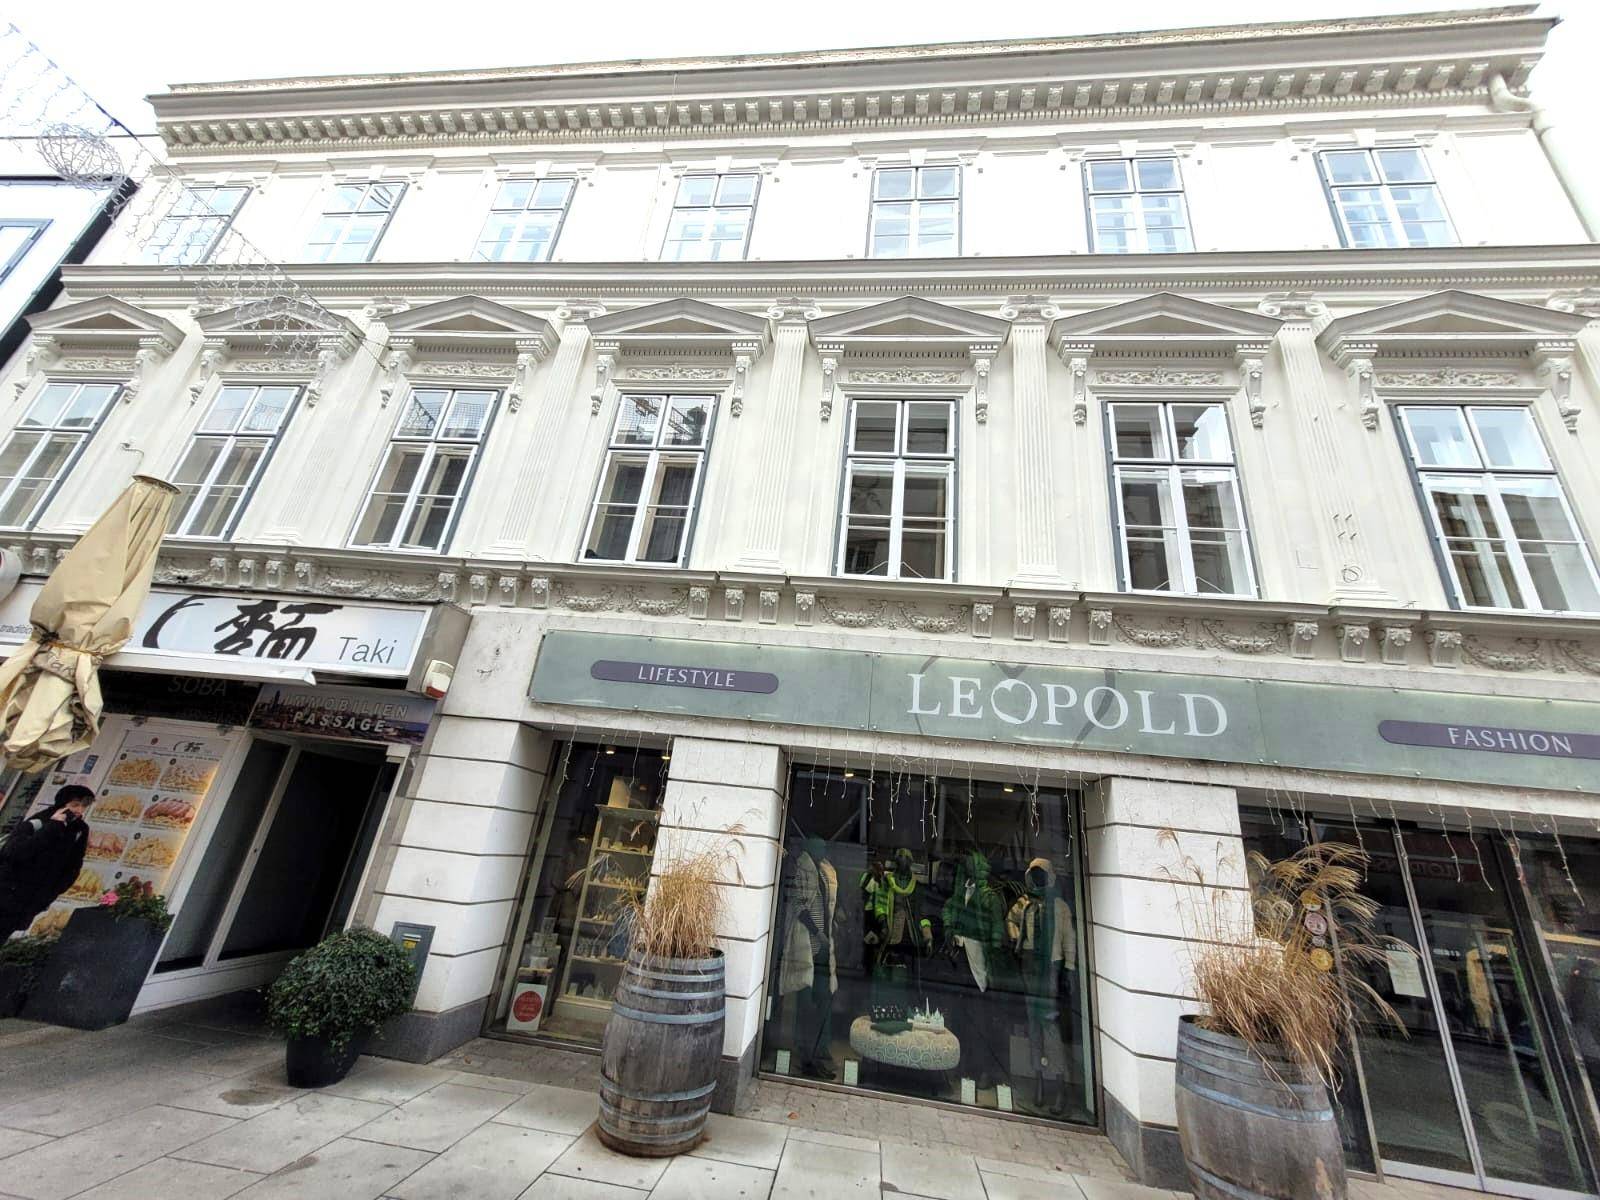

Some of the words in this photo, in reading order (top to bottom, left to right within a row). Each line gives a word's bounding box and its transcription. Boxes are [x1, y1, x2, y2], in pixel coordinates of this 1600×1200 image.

[337, 636, 397, 664] Taki
[167, 677, 227, 696] SOBA
[638, 665, 737, 688] LIFESTYLE
[284, 695, 408, 719] IMMOBILIEN
[906, 673, 1228, 737] LEOPOLD
[292, 711, 386, 732] PASSAGE
[1447, 727, 1573, 754] FASHION
